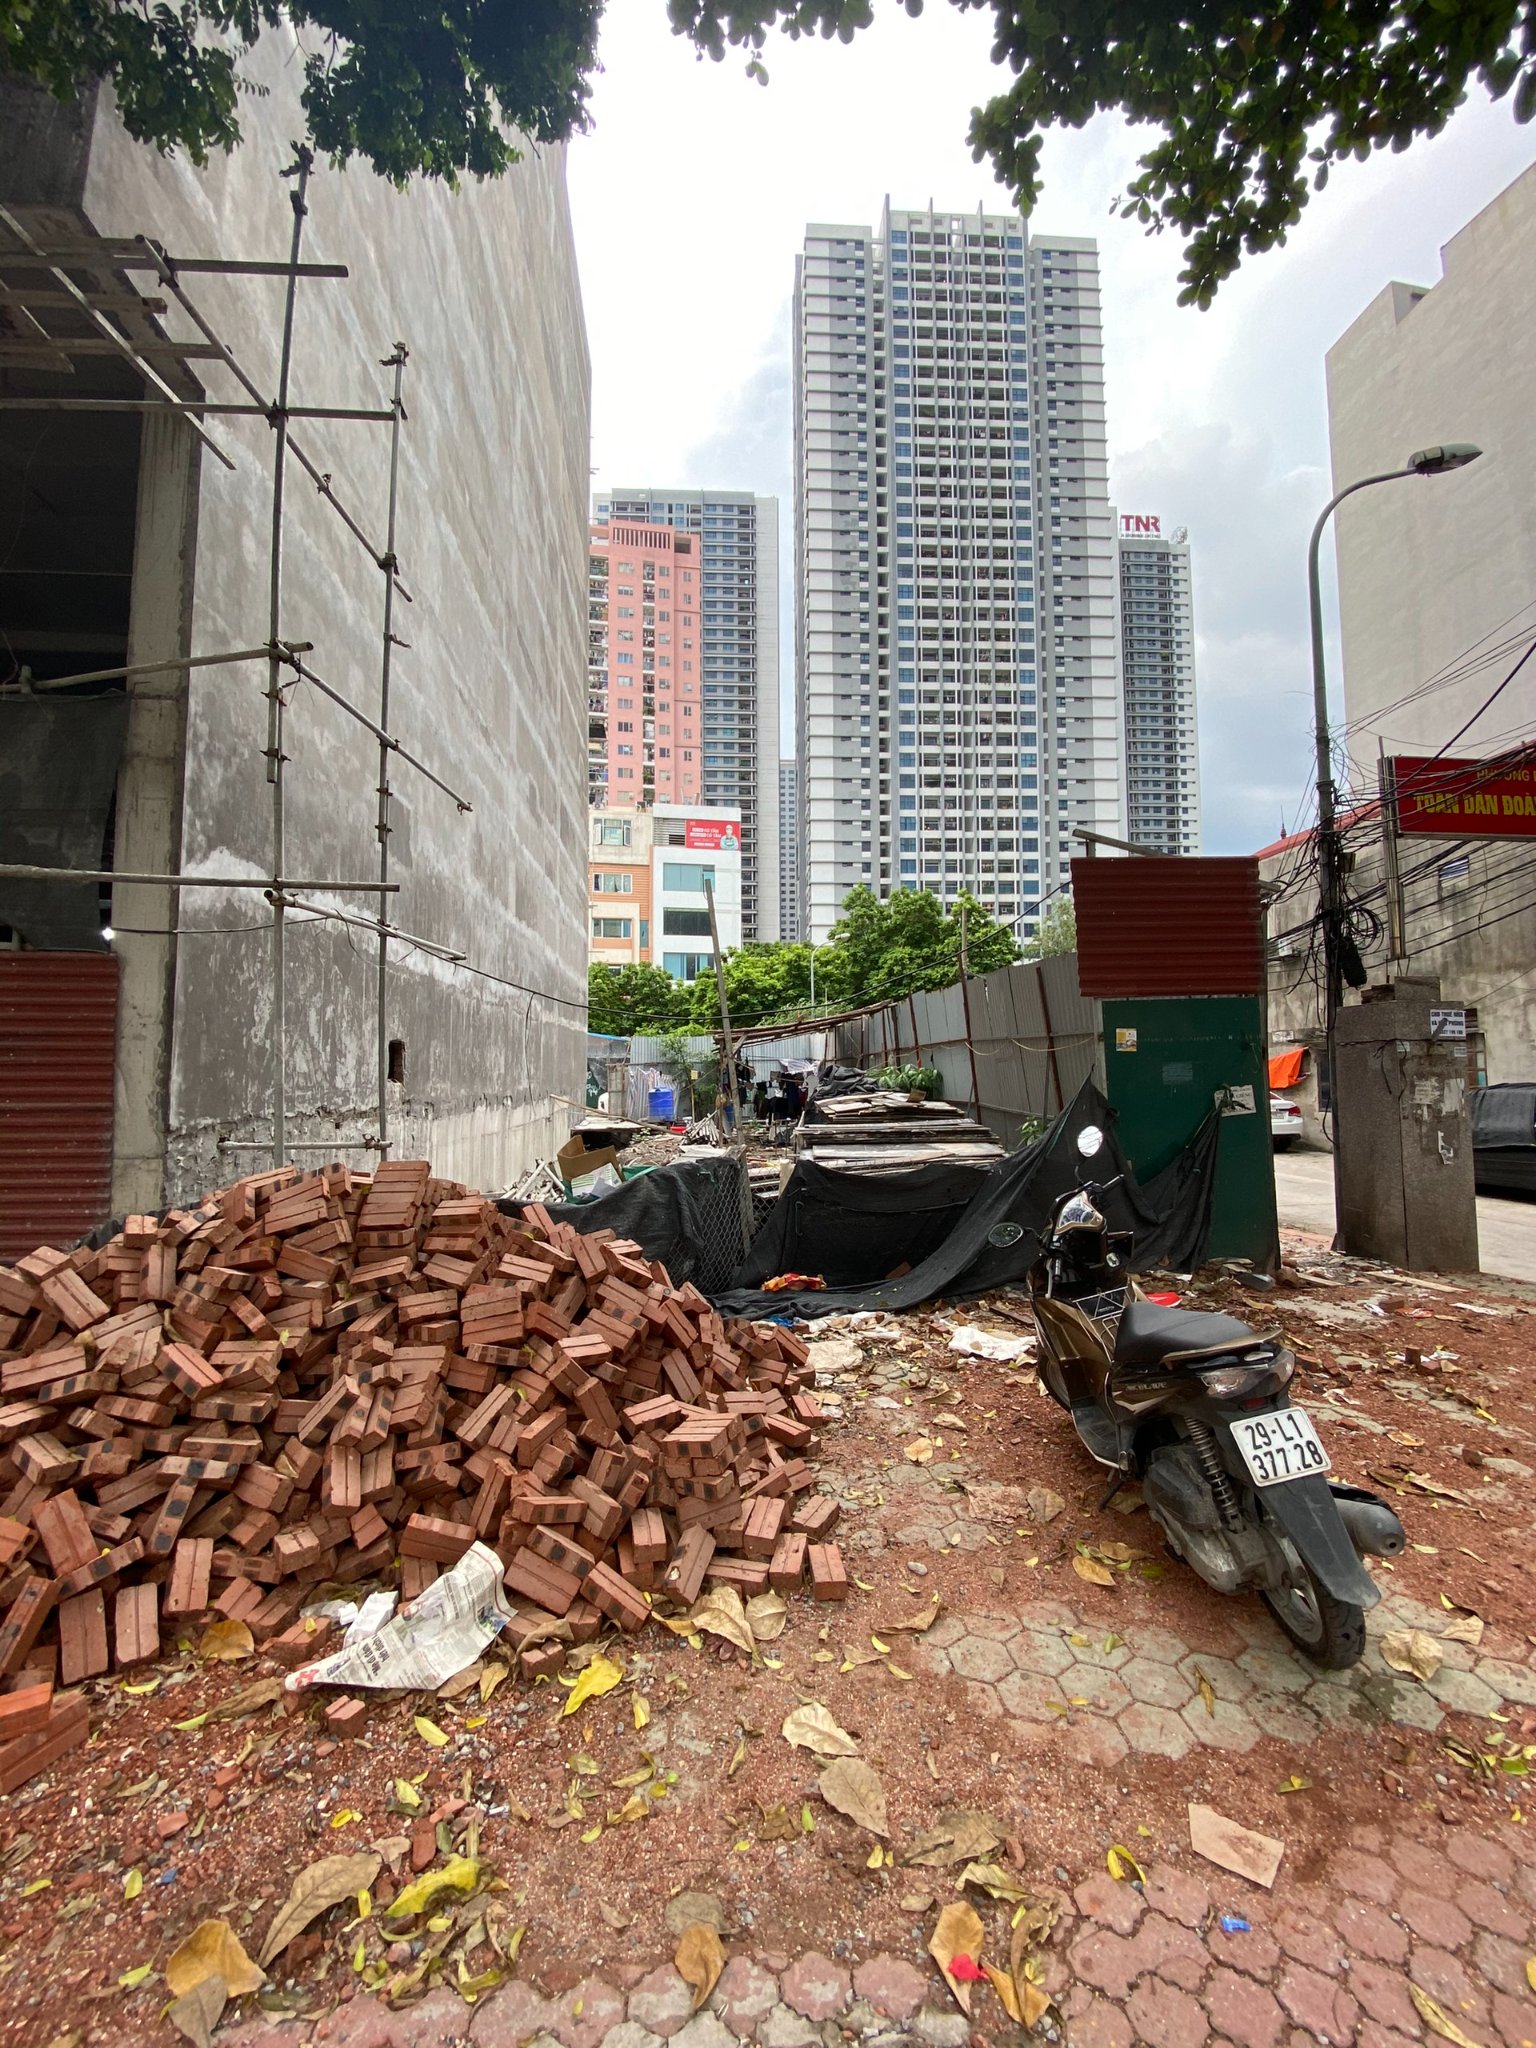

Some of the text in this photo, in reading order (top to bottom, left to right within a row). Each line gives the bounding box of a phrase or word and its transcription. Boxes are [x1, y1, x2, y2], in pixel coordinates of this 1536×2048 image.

[1120, 514, 1161, 532] TNR
[1463, 791, 1498, 815] DÂN
[1502, 792, 1536, 816] ĐOÀ
[1244, 1413, 1304, 1450] 29-L1
[1252, 1440, 1324, 1480] 377.28
